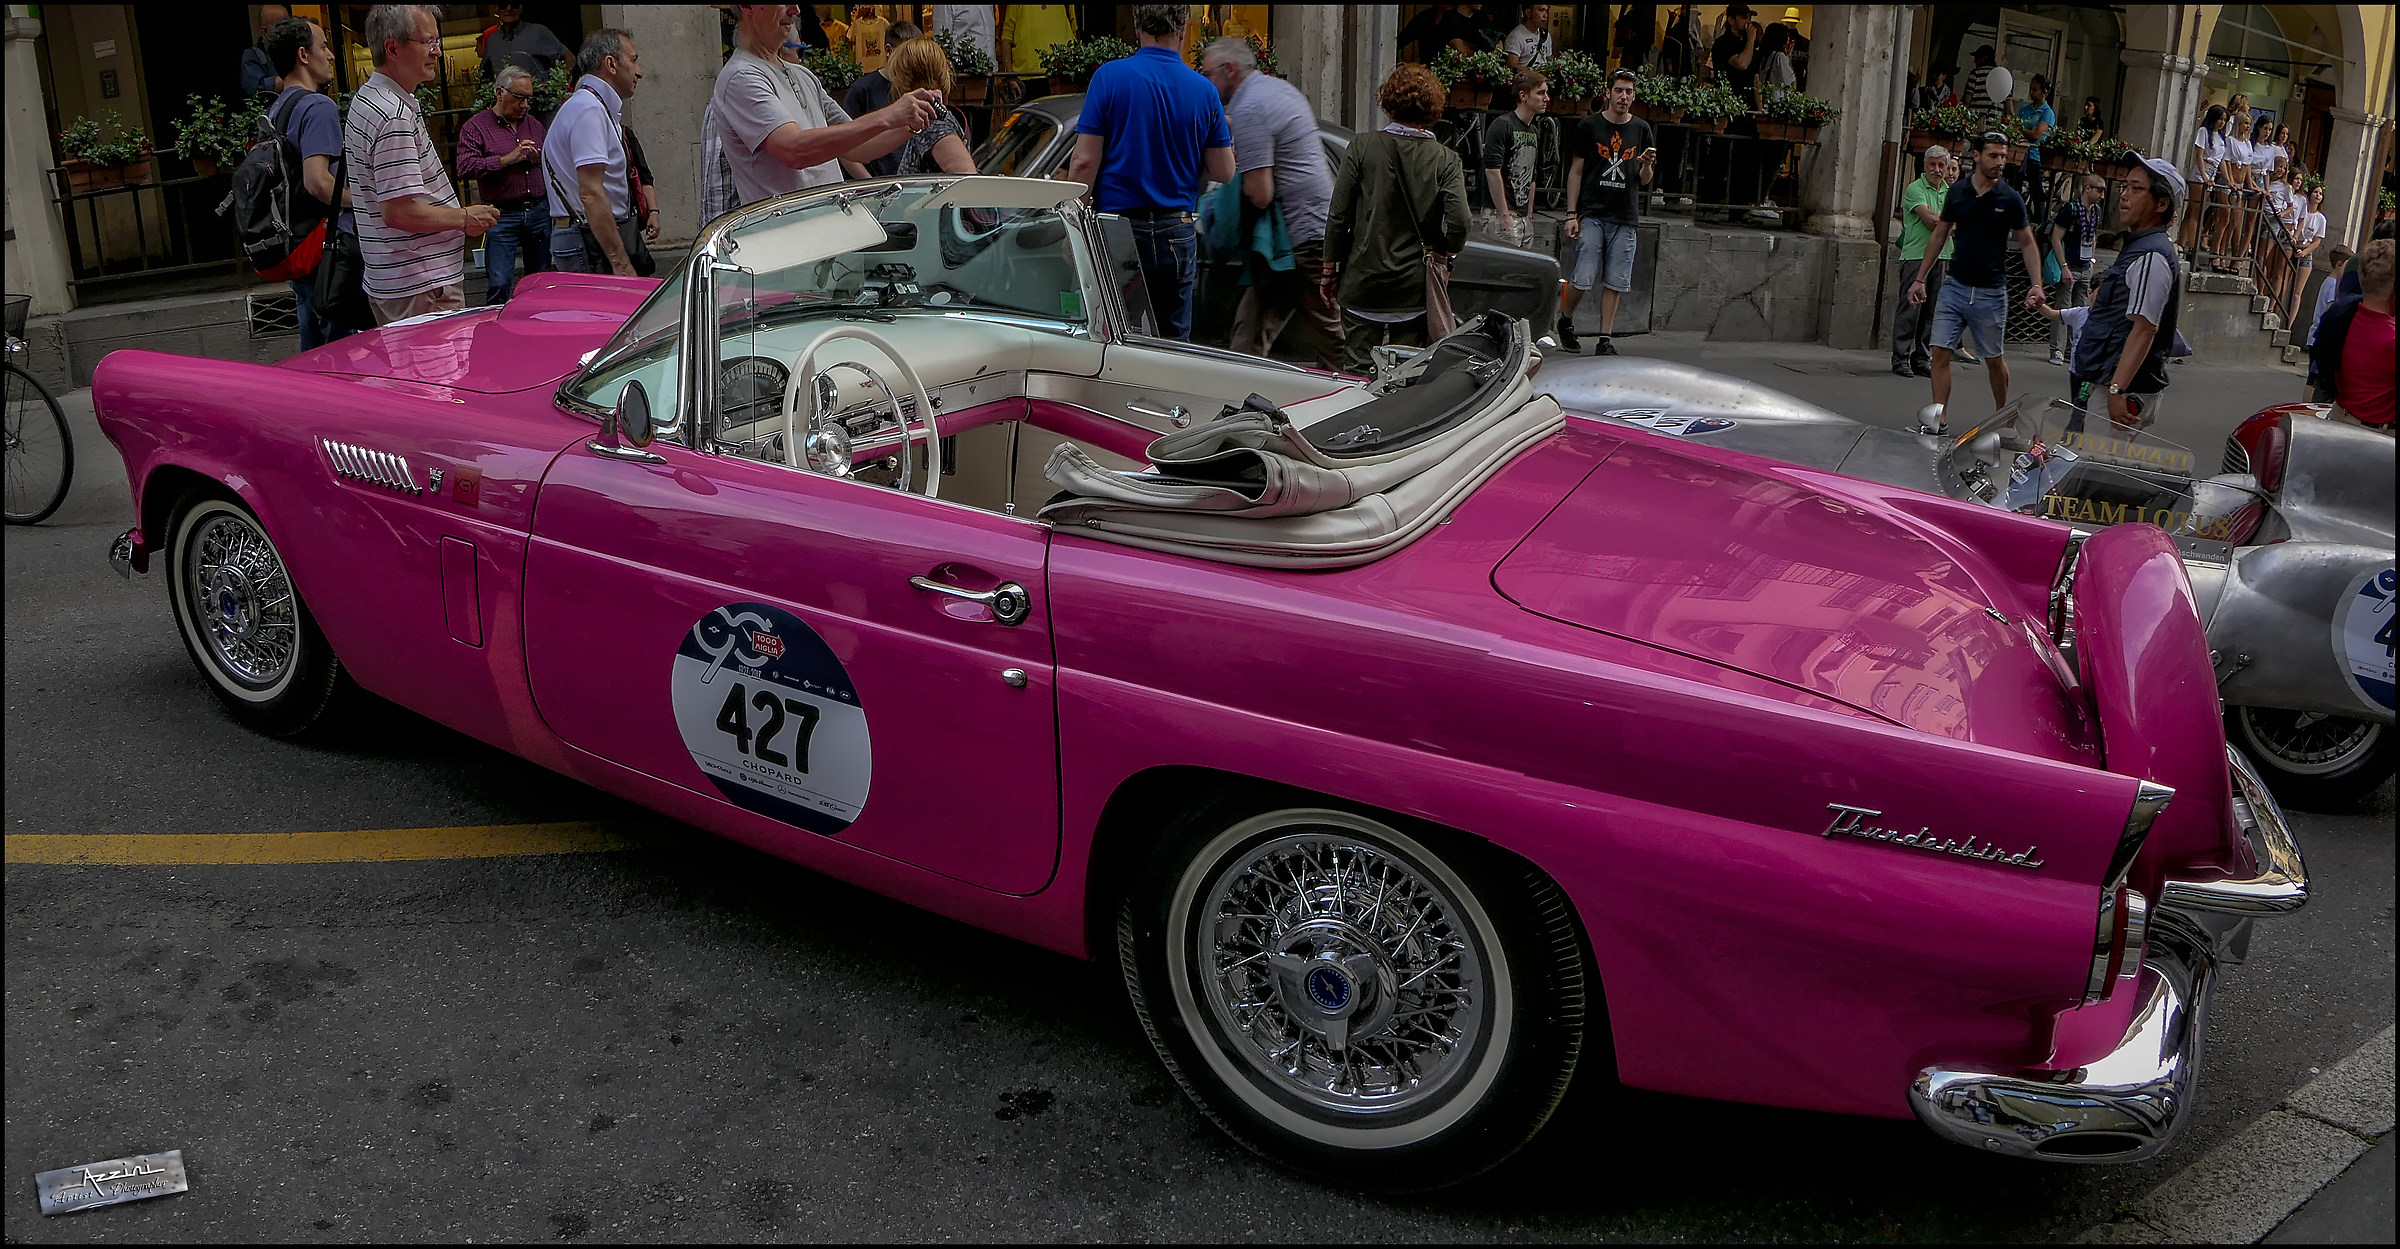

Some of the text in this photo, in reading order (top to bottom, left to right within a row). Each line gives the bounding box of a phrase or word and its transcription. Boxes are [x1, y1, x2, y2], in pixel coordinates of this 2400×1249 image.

[455, 478, 478, 494] KEY
[2043, 494, 2230, 538] TEAM LOTUS
[755, 643, 778, 655] MIGLIA
[757, 634, 777, 646] 1000
[716, 682, 820, 775] 427
[742, 759, 802, 785] CHOPARD
[1822, 802, 2044, 868] Thunderbird
